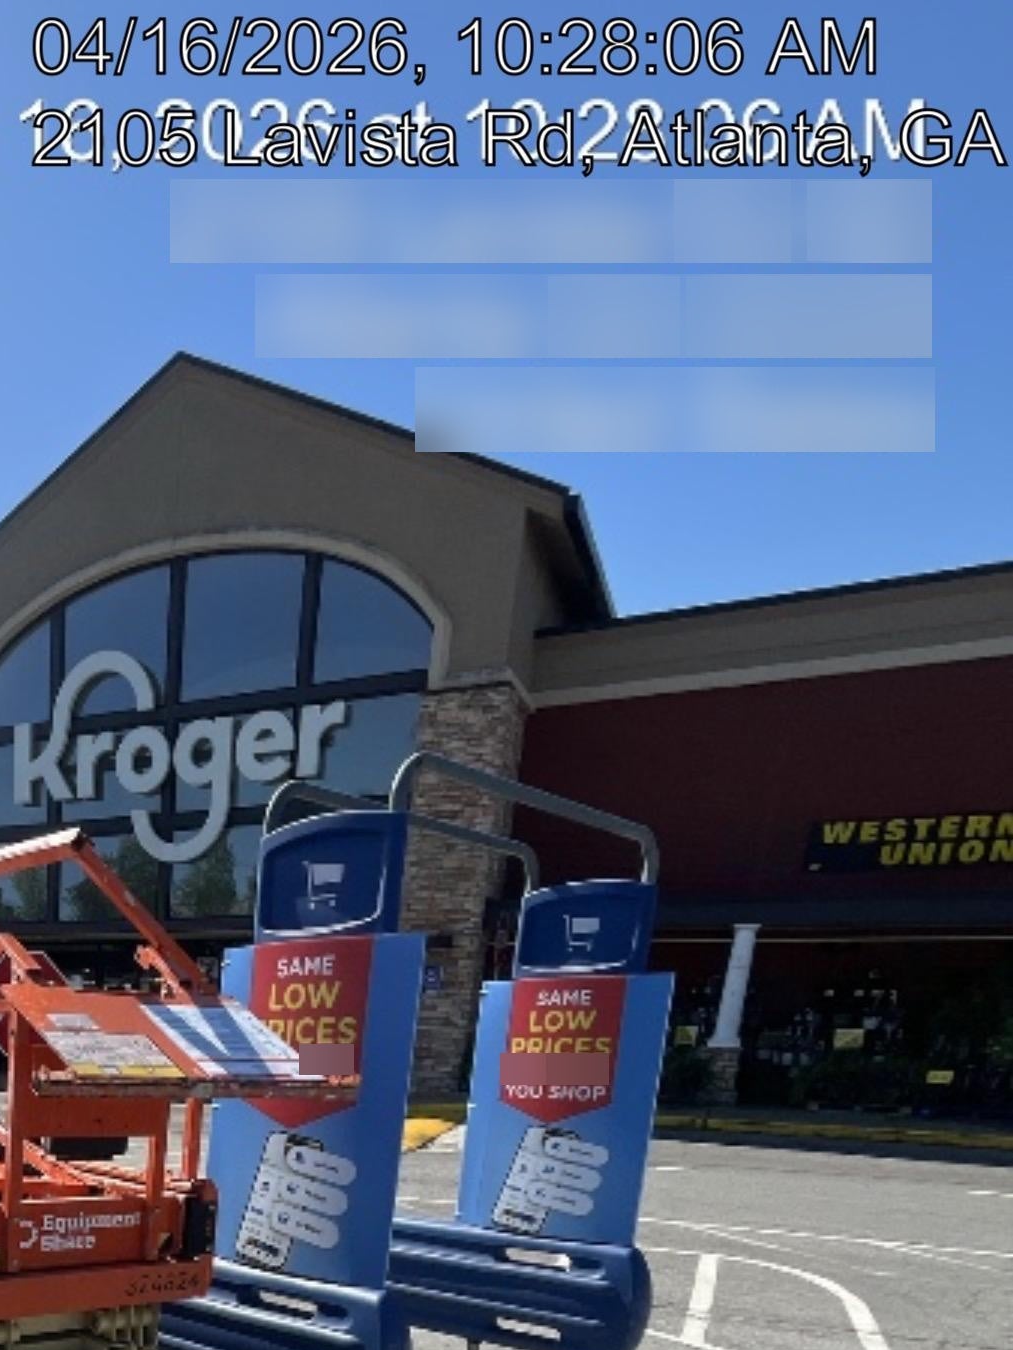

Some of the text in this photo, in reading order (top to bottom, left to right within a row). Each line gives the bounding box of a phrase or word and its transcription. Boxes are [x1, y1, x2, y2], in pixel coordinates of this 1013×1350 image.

[13, 650, 346, 862] Kroger
[823, 813, 1013, 844] WESTERN
[880, 839, 1013, 865] UNION
[277, 954, 336, 979] SAME
[269, 980, 341, 1011] LOW
[536, 989, 593, 1006] SAME
[262, 1015, 357, 1044] RICES
[529, 1009, 597, 1033] LOW
[505, 1085, 606, 1102] YOU SHOP
[43, 1212, 140, 1231] Equipment
